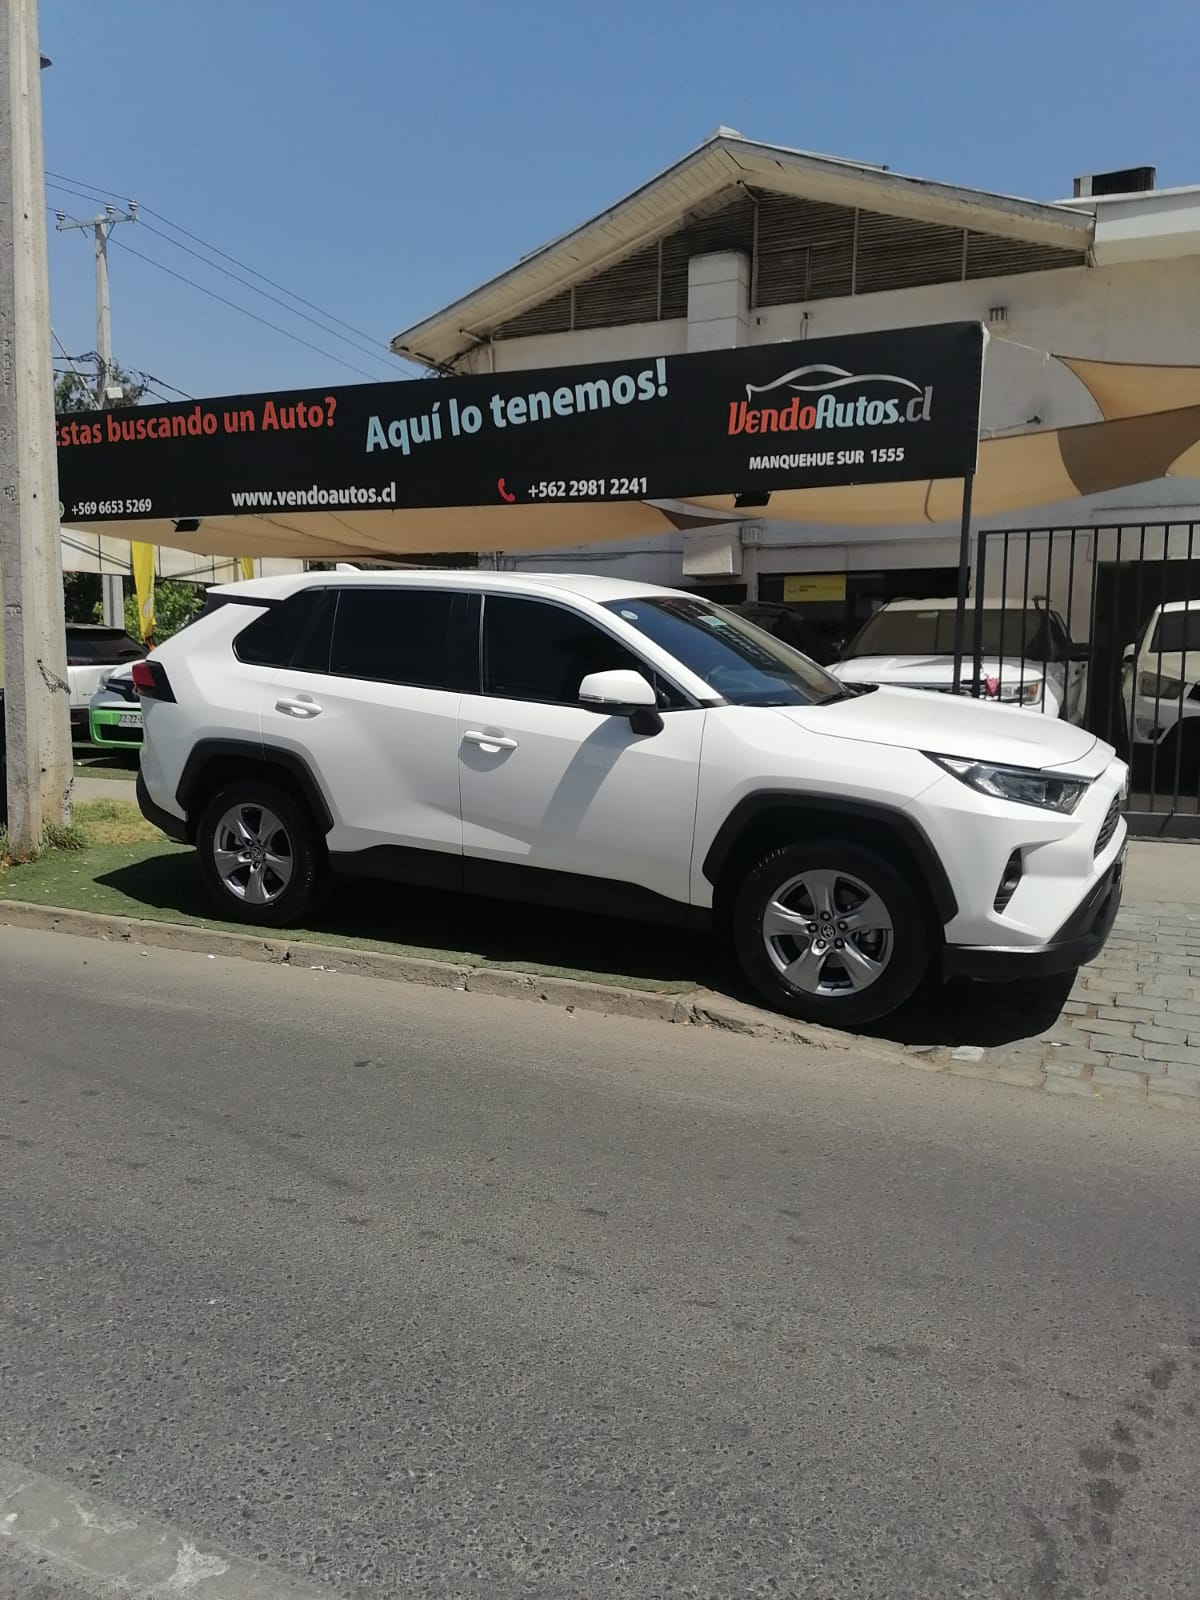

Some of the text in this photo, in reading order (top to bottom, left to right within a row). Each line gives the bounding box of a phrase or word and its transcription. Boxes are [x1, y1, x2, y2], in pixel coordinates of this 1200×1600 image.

[107, 405, 218, 442] buscando
[223, 409, 255, 433] un
[261, 396, 337, 431] Auto?
[365, 357, 668, 456] Aquí lo tenemos!
[728, 386, 934, 436] VendoAutos.cl
[749, 447, 905, 470] MANQUEHUE SUR 1555
[231, 481, 397, 507] www.vendoautos.cl
[528, 476, 647, 498] +562 2981 2241
[71, 498, 152, 516] +569 6653 5269
